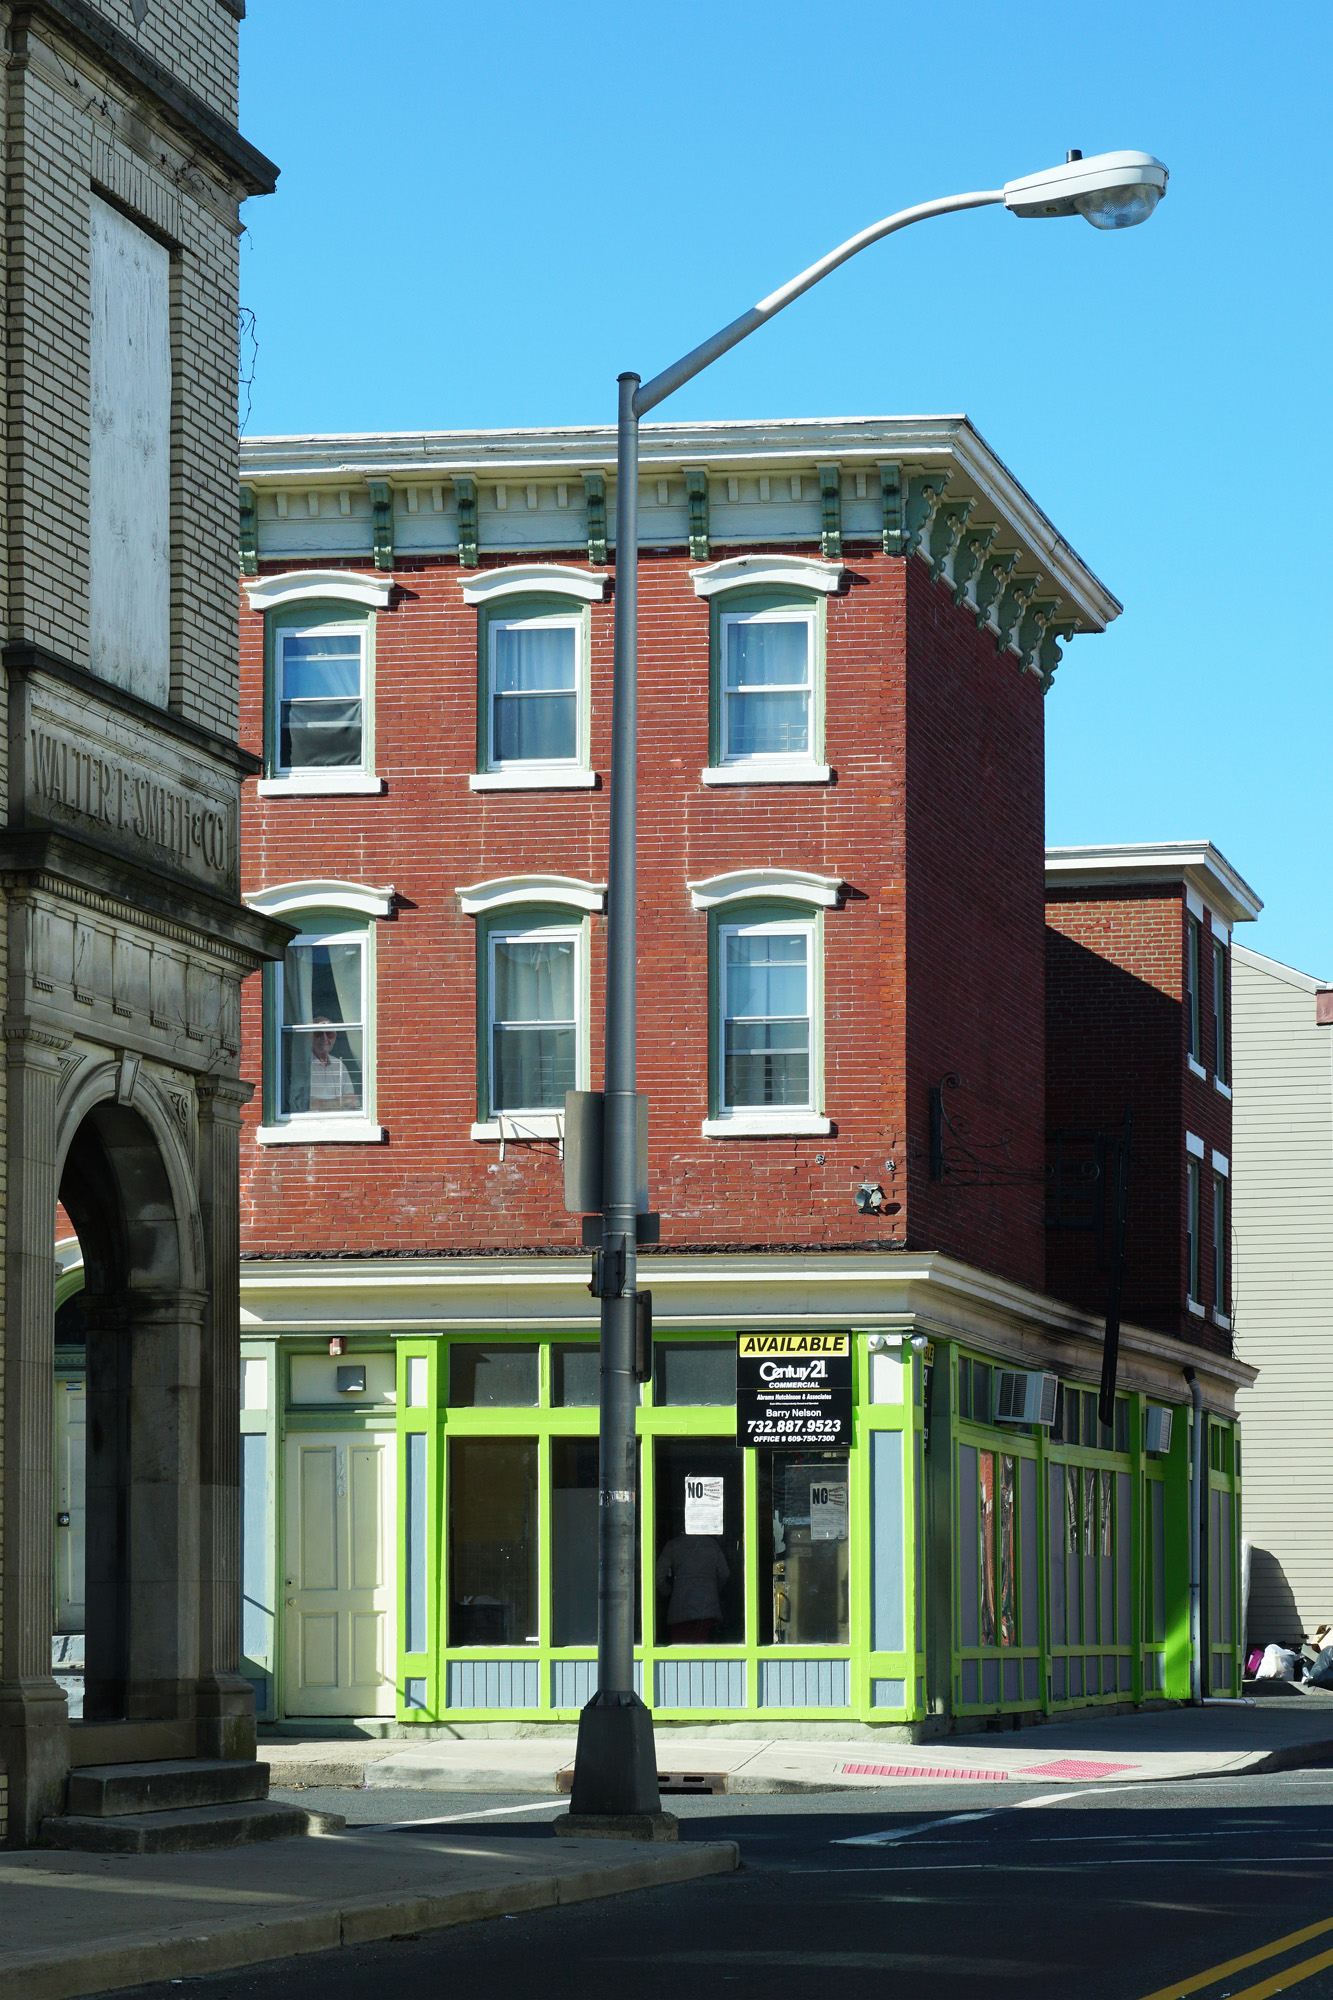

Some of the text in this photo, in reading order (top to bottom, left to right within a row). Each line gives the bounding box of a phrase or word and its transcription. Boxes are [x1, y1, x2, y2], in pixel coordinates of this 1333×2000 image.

[30, 729, 113, 824] WALTER
[132, 777, 192, 859] SMITH
[192, 813, 201, 848] &
[744, 1336, 845, 1352] AVAILABLE
[766, 1408, 822, 1418] Barry Nelson
[747, 1420, 841, 1433] 732.887.9523
[787, 1434, 835, 1442] 609-750-7300
[688, 1481, 703, 1499] NO
[812, 1487, 828, 1504] NO
